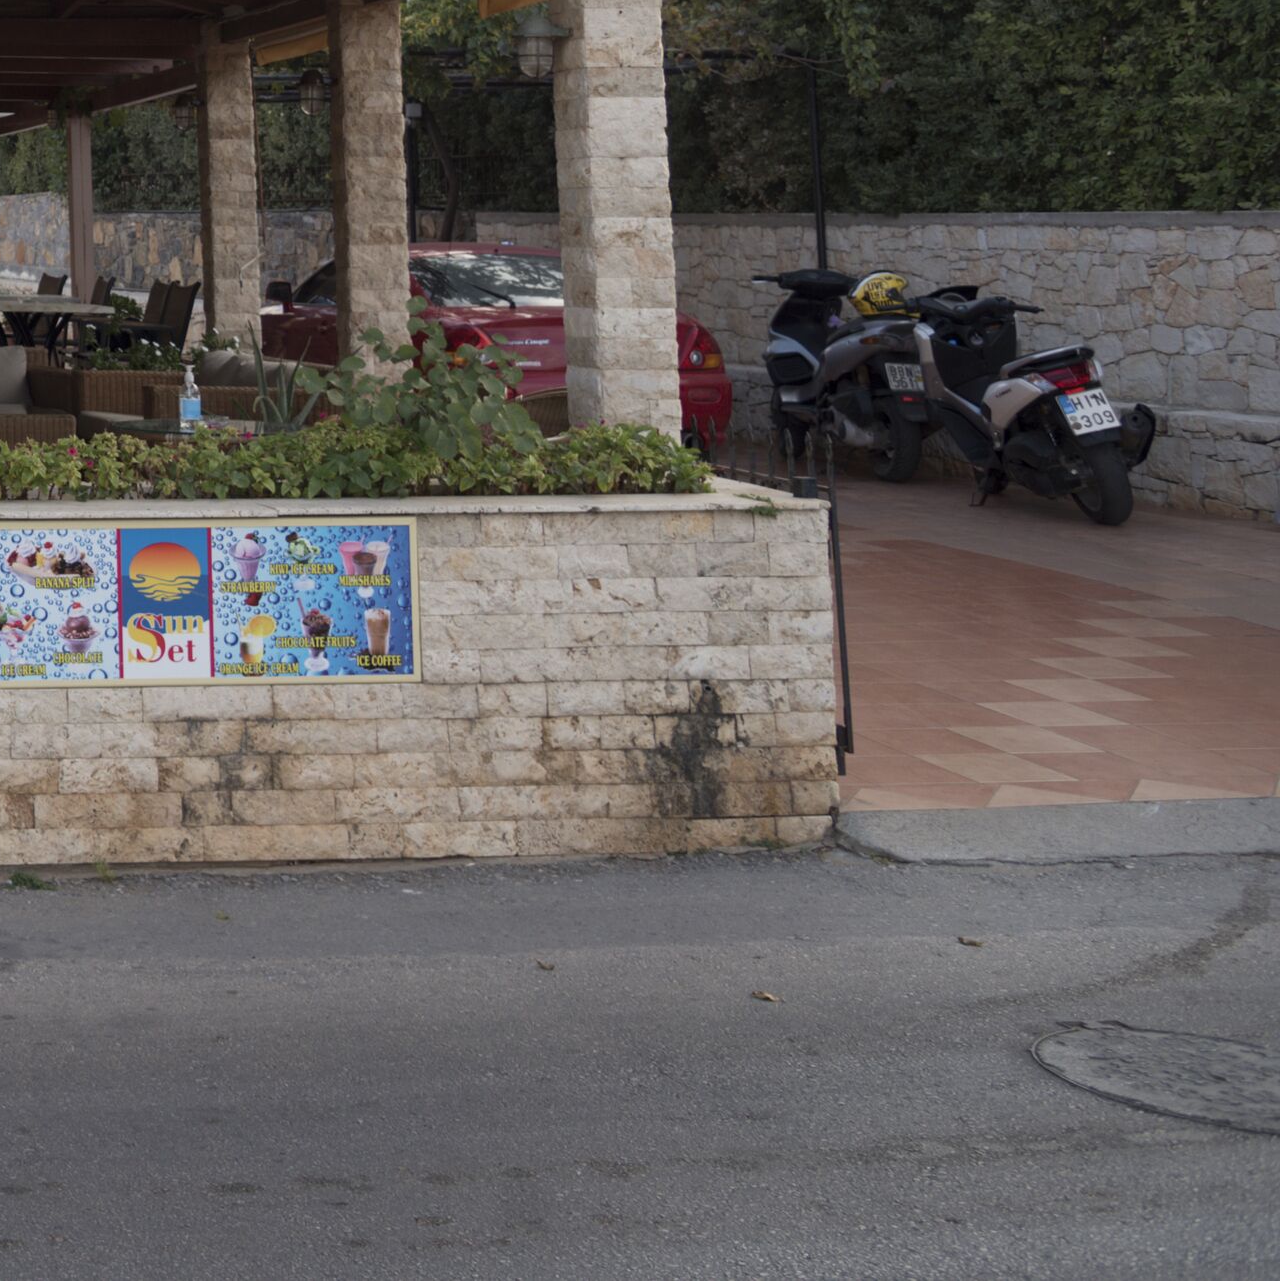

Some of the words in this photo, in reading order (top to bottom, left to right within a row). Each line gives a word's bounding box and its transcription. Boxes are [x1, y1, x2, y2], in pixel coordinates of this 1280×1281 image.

[1070, 392, 1107, 411] HIN
[1081, 410, 1115, 428] 309
[269, 563, 289, 574] KIWI
[291, 563, 304, 574] ICE
[305, 563, 335, 574] CREAM
[35, 577, 69, 589] BANANA
[72, 577, 95, 588] SPLIT
[339, 575, 391, 586] MILKSHAKES
[220, 581, 276, 593] STRAWBERRY
[126, 612, 204, 663] Sun
[135, 613, 197, 663] Set
[276, 637, 325, 648] CHOCOLATE
[327, 636, 356, 647] FRUITS
[52, 652, 103, 664] CHOCOLATE
[357, 655, 370, 666] ICE
[372, 655, 402, 666] COFFEE
[2, 665, 15, 676] ICE
[17, 665, 46, 676] CREAM
[220, 663, 255, 675] ORANGE
[255, 663, 269, 674] ICE
[271, 663, 299, 674] CREAM
